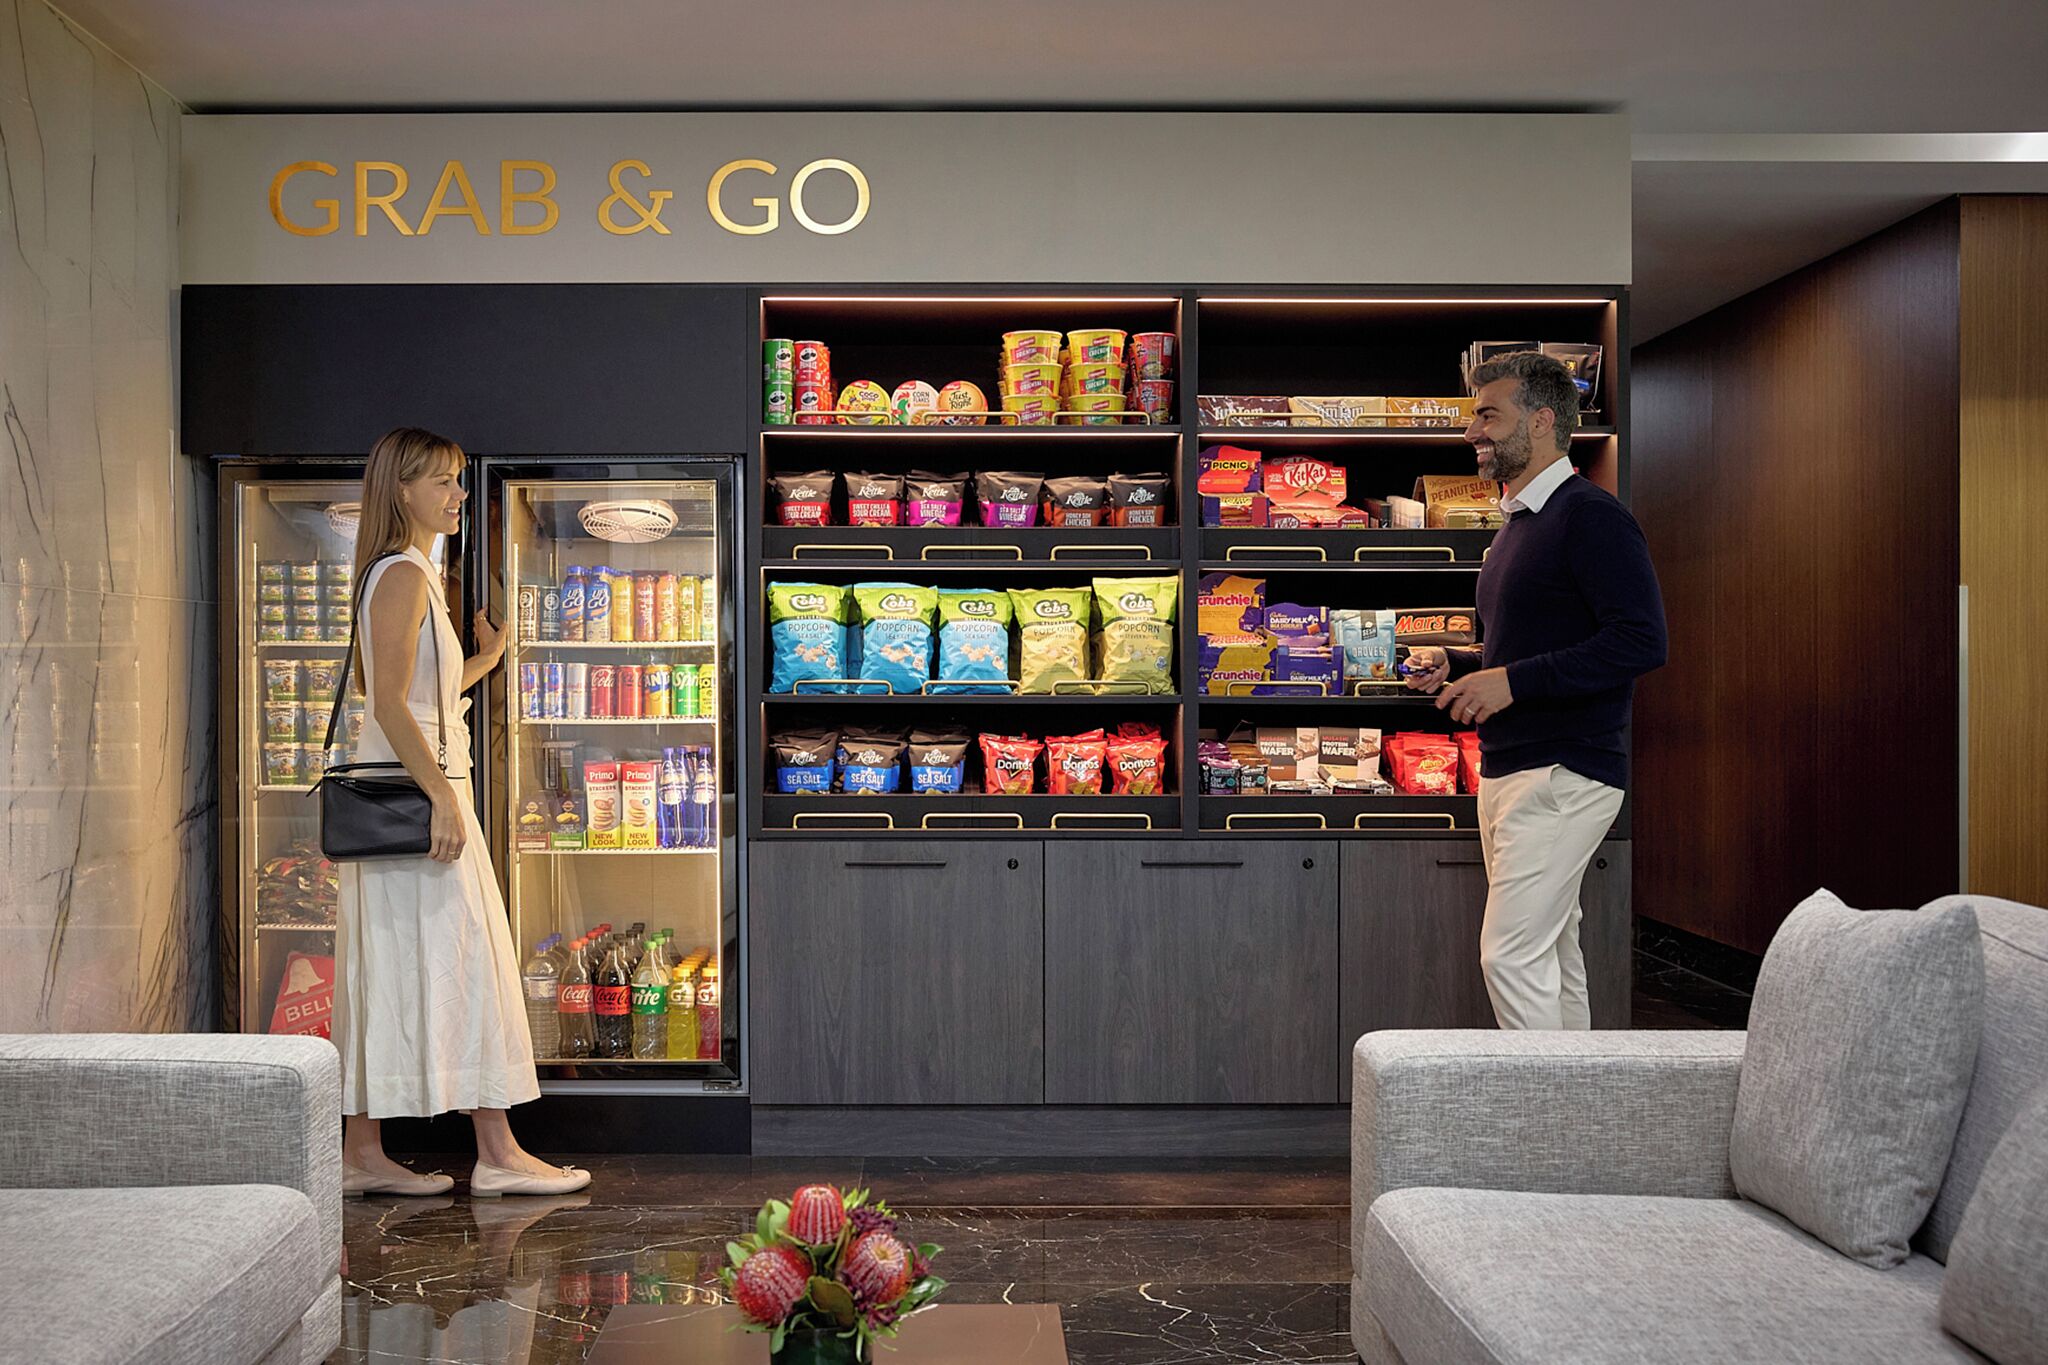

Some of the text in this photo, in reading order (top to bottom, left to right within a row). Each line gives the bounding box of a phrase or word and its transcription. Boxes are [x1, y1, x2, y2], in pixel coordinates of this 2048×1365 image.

[268, 159, 871, 236] GRAB & GO
[858, 391, 880, 399] COCO
[912, 391, 930, 399] CORN
[1212, 461, 1247, 469] PICNIC
[1288, 464, 1325, 488] KitKat
[789, 486, 817, 500] Kettle
[858, 485, 886, 499] Kettle
[922, 486, 949, 499] Kettle
[1000, 488, 1028, 502] Kettle
[1127, 490, 1155, 504] Kettle
[1431, 484, 1470, 503] PEANUT
[1470, 480, 1492, 492] SLAB
[1065, 494, 1093, 507] Kettle
[1065, 518, 1091, 526] CHICKEN
[1128, 515, 1155, 523] CHICKEN
[790, 594, 827, 612] Cobs
[880, 594, 916, 612] Cobs
[1119, 593, 1155, 613] Cobs
[1198, 594, 1251, 606] crunchie
[959, 600, 996, 616] Cobs
[1035, 600, 1071, 617] Cobs
[788, 623, 830, 631] POPCORN
[877, 622, 919, 632] POPCORN
[956, 624, 998, 632] POPCORN
[1119, 623, 1160, 633] POPCORN
[1395, 615, 1445, 633] Mars
[1213, 669, 1261, 681] crunchie
[855, 751, 884, 765] Kettle
[921, 751, 950, 765] Kettle
[1260, 747, 1294, 756] WAFER
[1322, 747, 1355, 756] WAFER
[790, 752, 818, 765] Kettle
[997, 759, 1033, 770] Doritos
[1120, 757, 1156, 771] Doritos
[589, 771, 615, 781] Primo
[626, 771, 651, 780] Primo
[787, 775, 821, 784] SEA SALT
[850, 774, 886, 785] SEA SALT
[917, 774, 952, 785] SEA SALT
[631, 989, 660, 1006] rite
